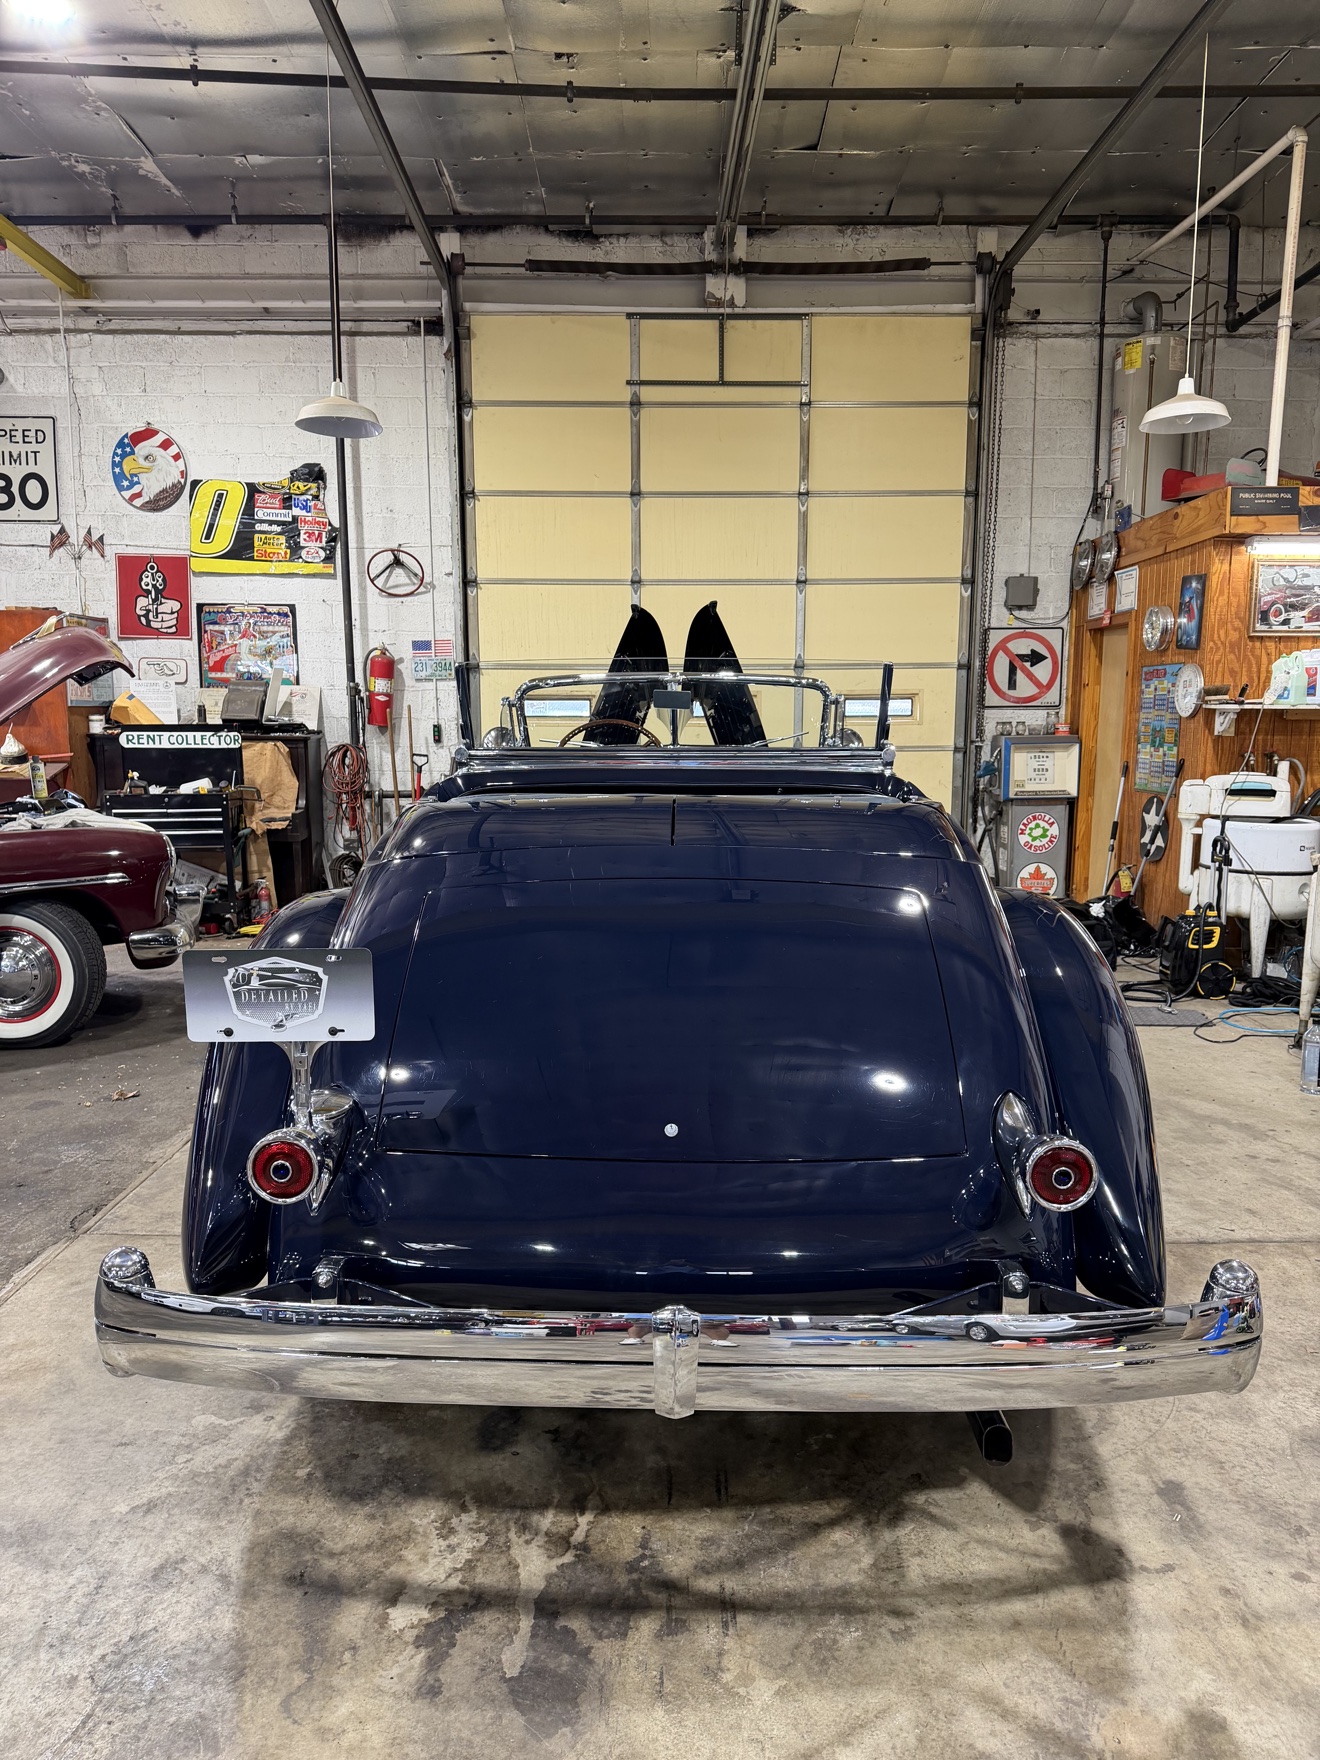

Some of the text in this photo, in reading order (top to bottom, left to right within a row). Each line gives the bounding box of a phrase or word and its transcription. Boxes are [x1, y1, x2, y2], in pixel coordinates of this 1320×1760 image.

[0, 429, 46, 444] PEED
[0, 451, 40, 466] IMIT
[256, 494, 281, 504] Bud
[255, 509, 291, 519] Commit
[299, 517, 328, 529] Holley
[303, 531, 324, 544] 3M
[414, 662, 452, 672] 231 3944
[126, 734, 240, 746] RENT COLLECTOR
[1019, 814, 1056, 836] MAGNOLIA
[1023, 833, 1057, 853] GASOLINE
[240, 988, 309, 1002] DETAILED
